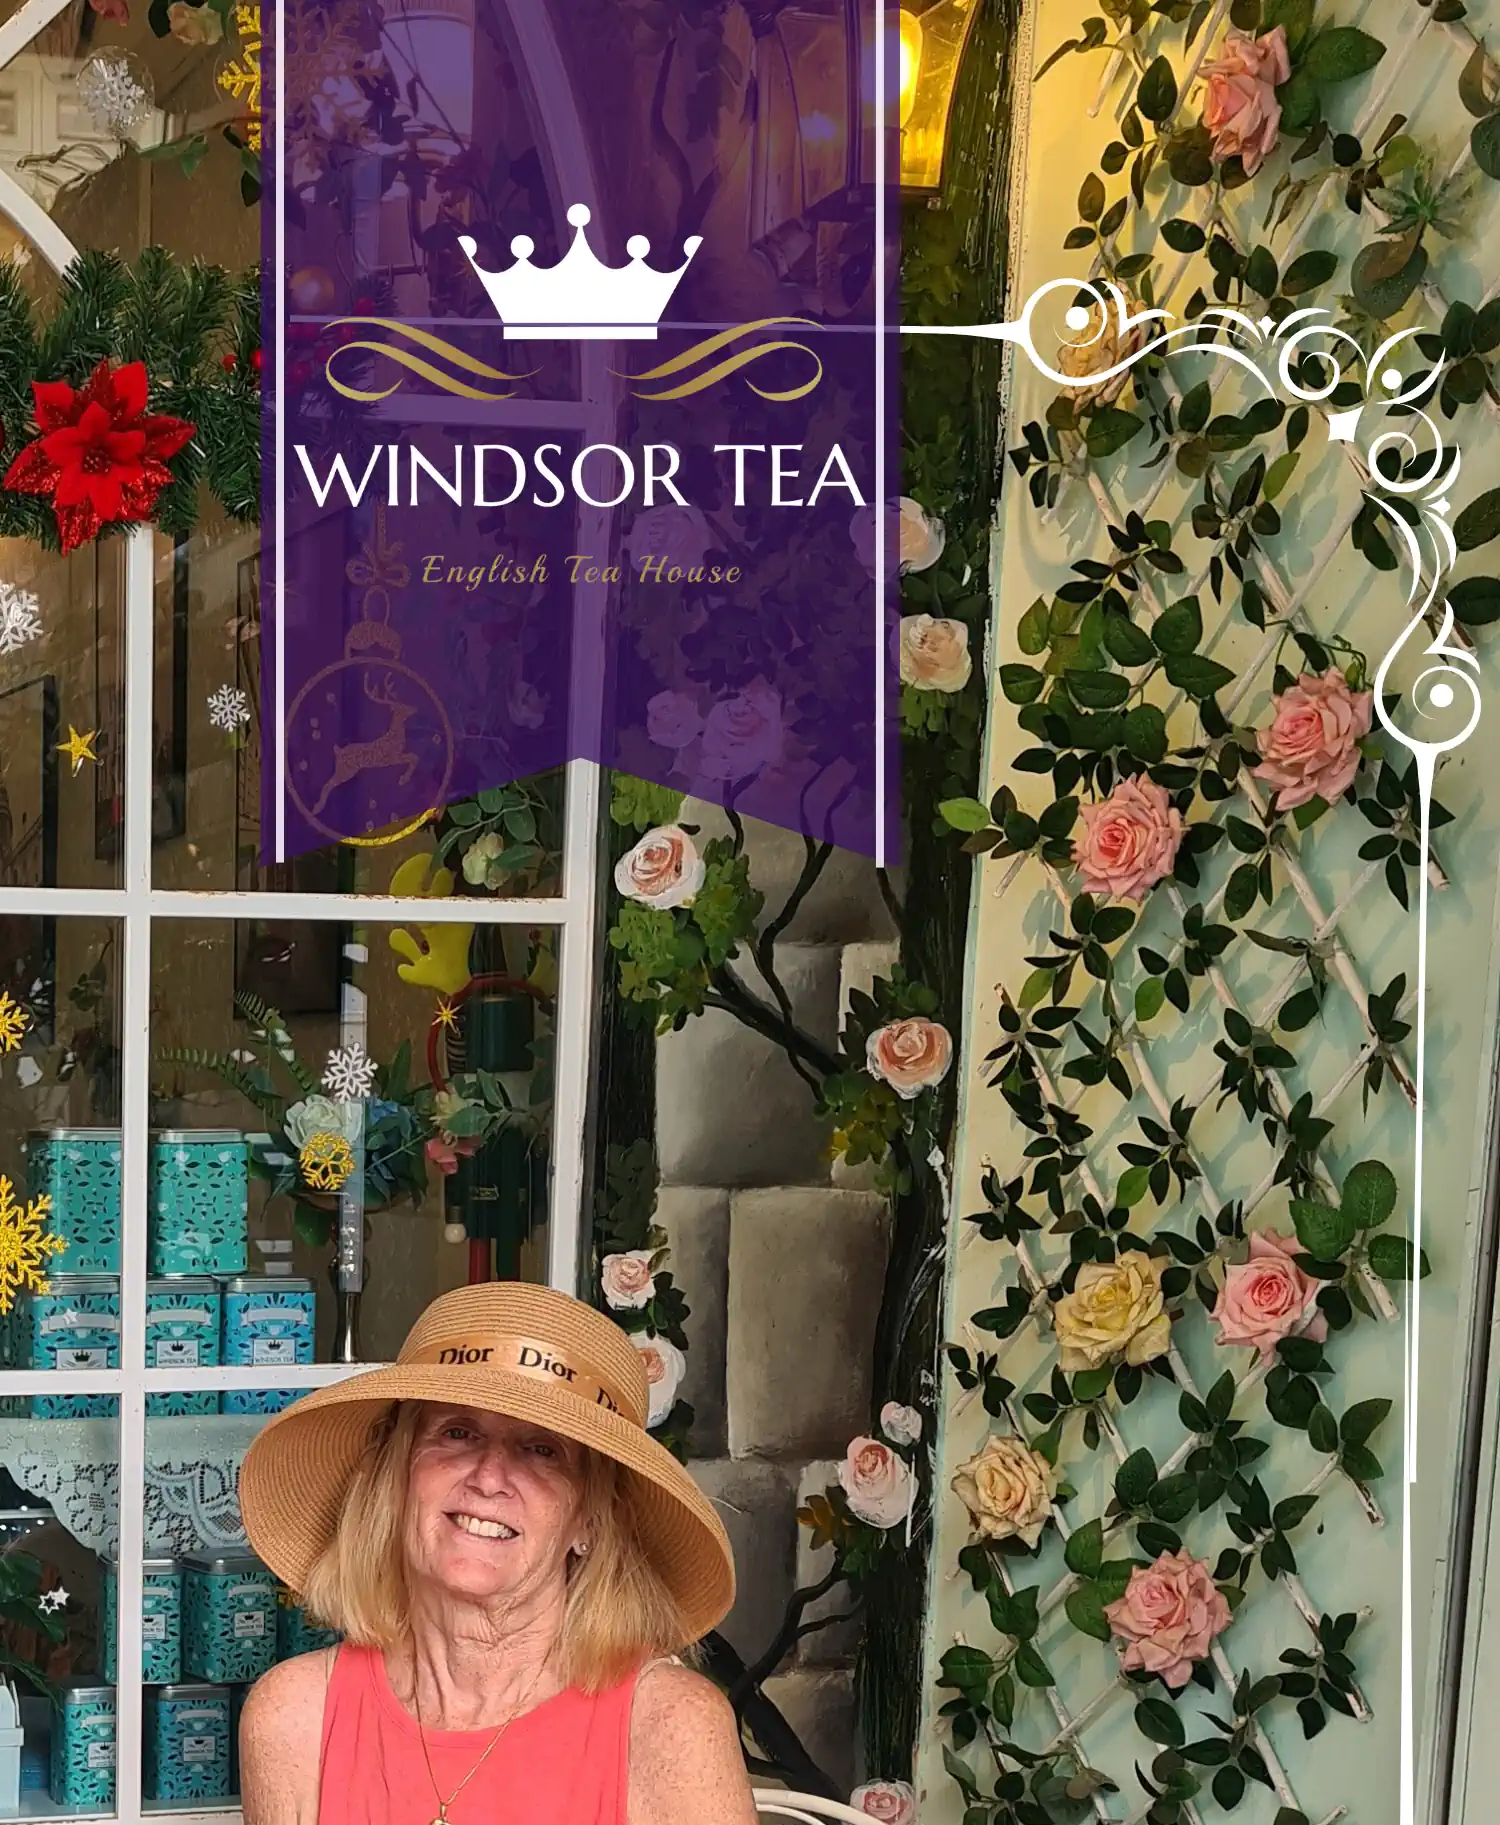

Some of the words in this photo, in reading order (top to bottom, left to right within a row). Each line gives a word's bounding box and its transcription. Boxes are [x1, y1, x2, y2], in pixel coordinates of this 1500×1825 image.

[439, 1344, 495, 1365] Dior
[519, 1346, 578, 1384] Dior
[596, 1386, 626, 1417] Di
